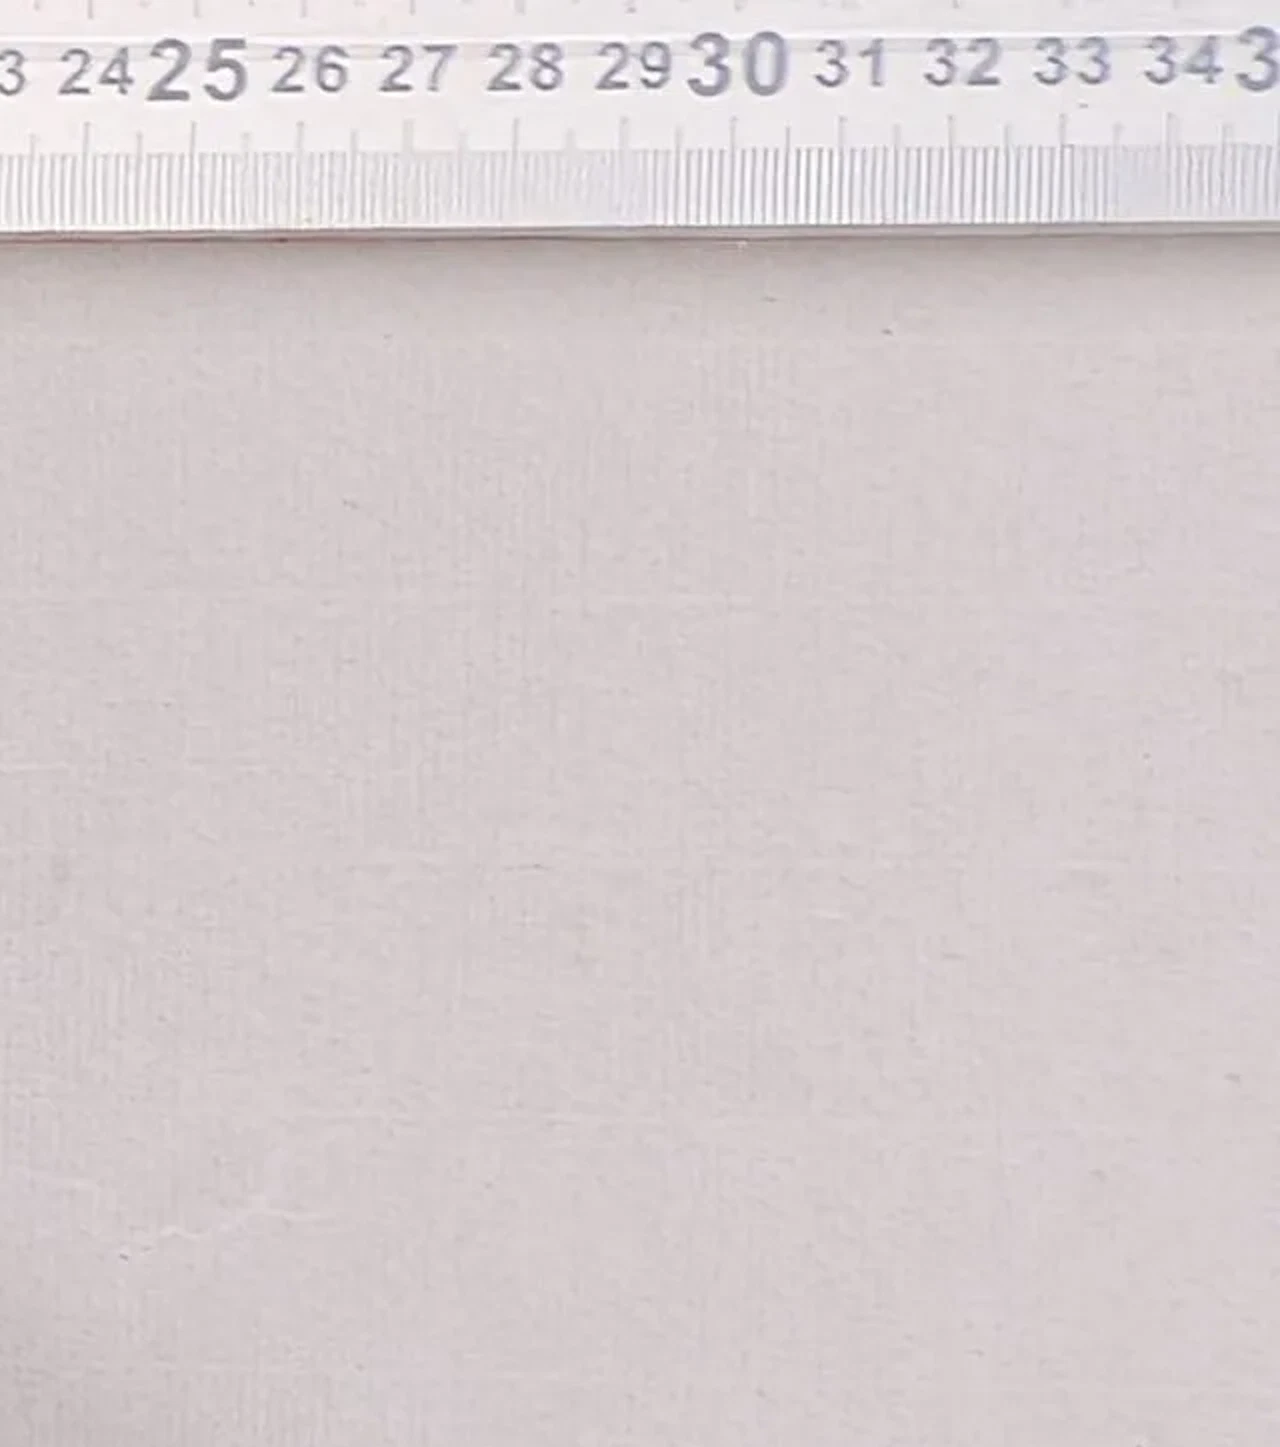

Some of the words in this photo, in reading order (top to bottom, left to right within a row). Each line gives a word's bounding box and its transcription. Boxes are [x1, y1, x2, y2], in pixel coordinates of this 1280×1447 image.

[56, 46, 135, 95] 24
[145, 38, 248, 102] 25
[269, 45, 351, 93] 26
[378, 44, 458, 92] 27
[486, 42, 564, 91] 28
[595, 41, 673, 90] 29
[687, 31, 790, 97] 30
[813, 38, 885, 88] 31
[923, 38, 1002, 87] 32
[1032, 36, 1111, 86] 33
[1144, 35, 1224, 85] 34
